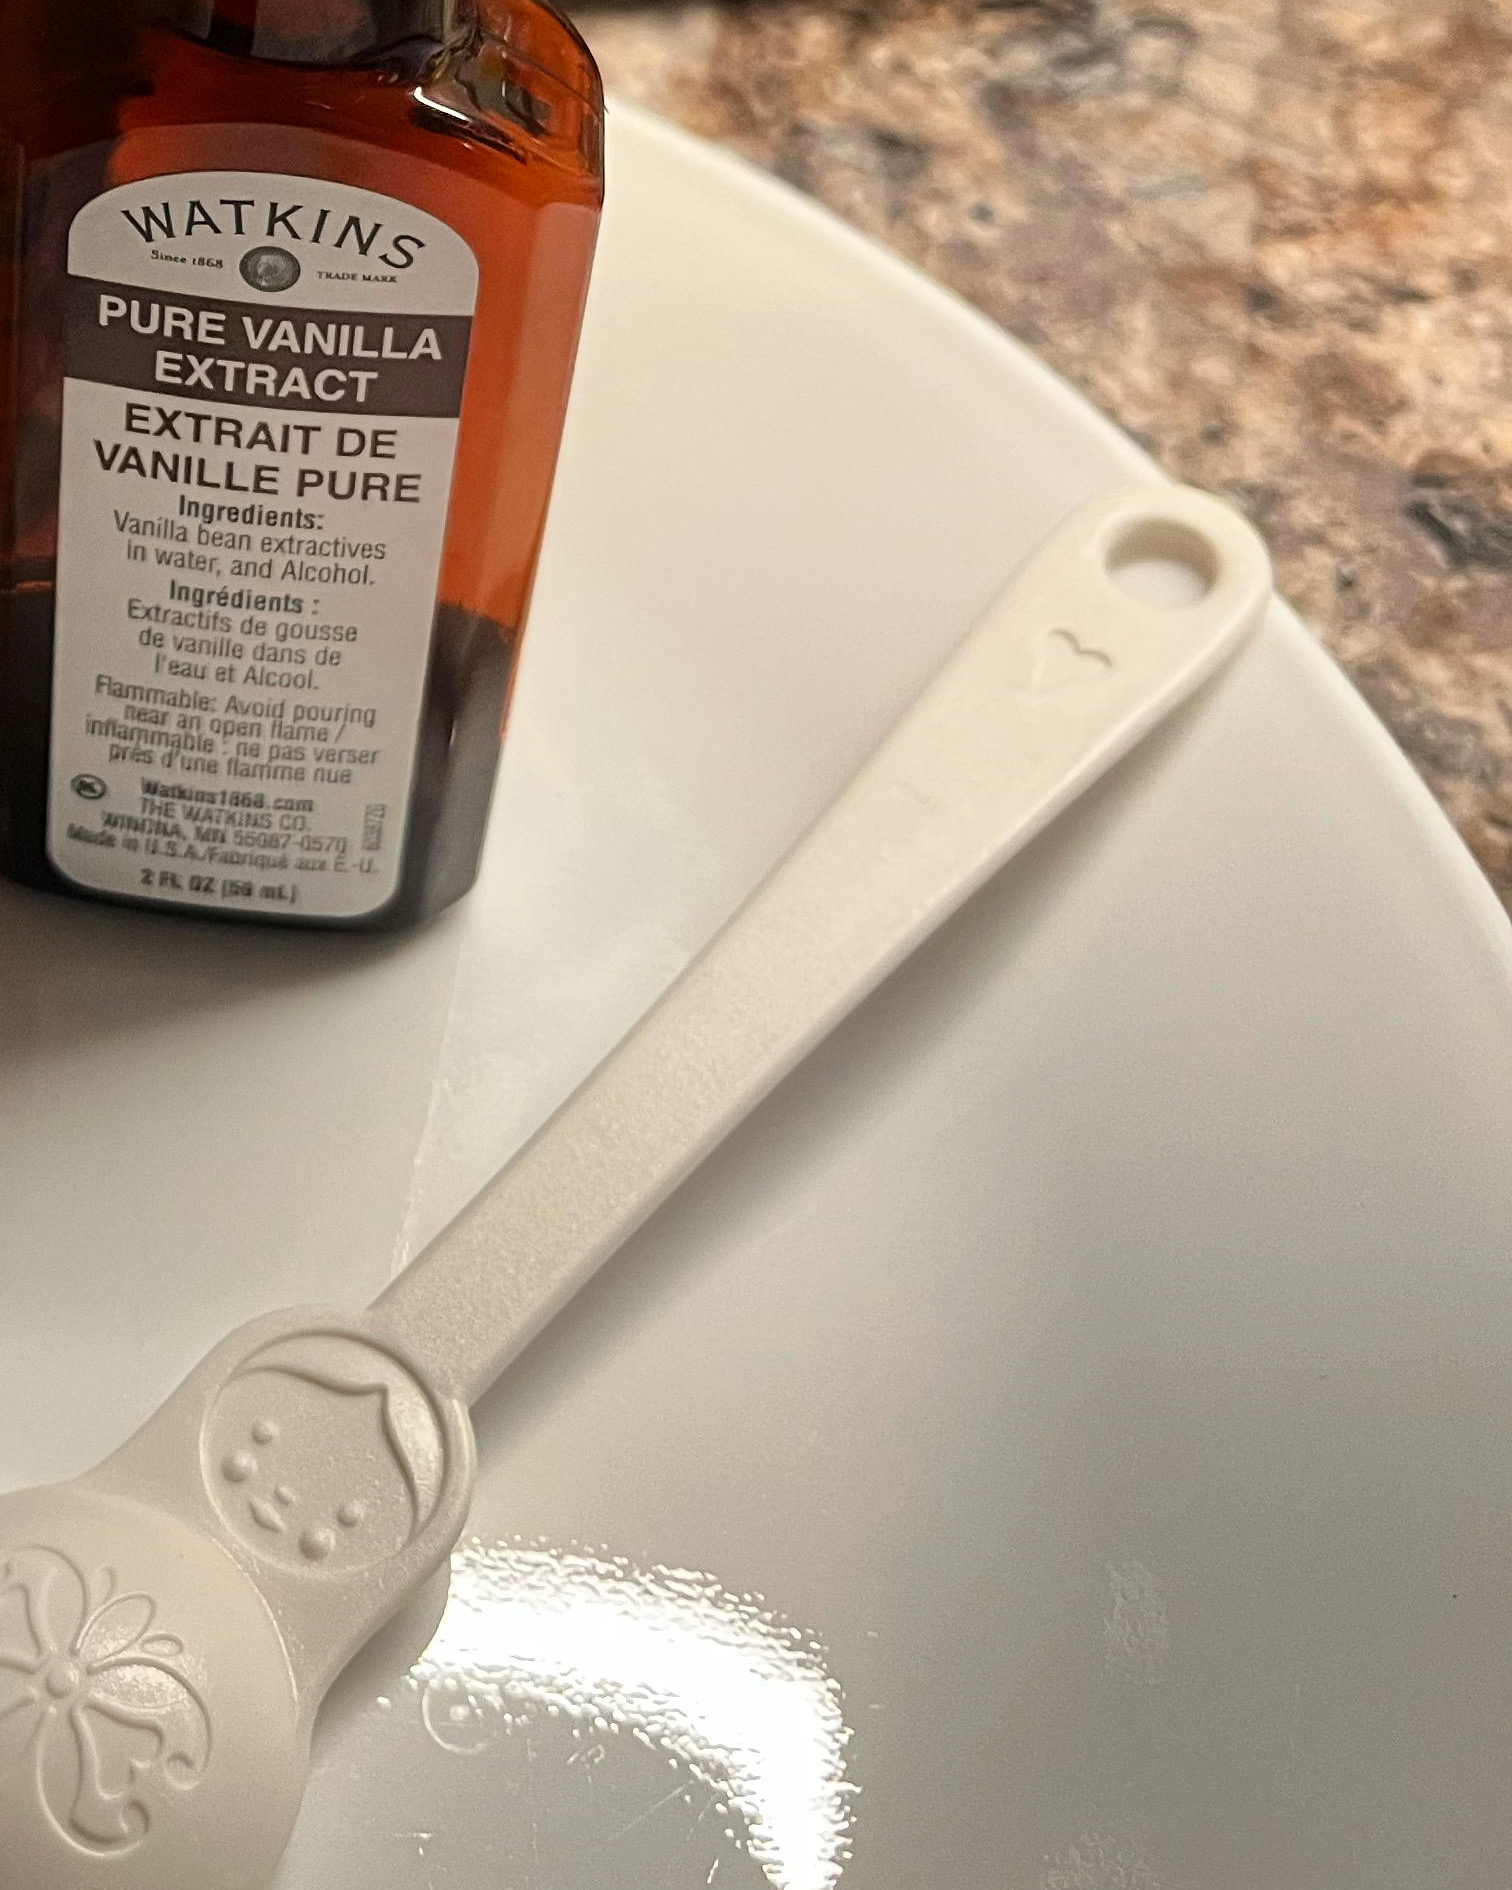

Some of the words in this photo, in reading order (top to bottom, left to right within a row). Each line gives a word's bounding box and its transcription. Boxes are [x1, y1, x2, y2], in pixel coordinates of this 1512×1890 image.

[121, 199, 425, 269] WATKINS
[151, 249, 187, 265] Since
[316, 271, 358, 283] TRADE
[362, 273, 398, 284] MARK
[98, 294, 226, 345] PURE
[242, 316, 442, 360] VANILLA
[155, 350, 378, 402] EXTRACT
[124, 402, 321, 455] EXTRAIT
[336, 428, 398, 459] DE
[94, 439, 280, 495] VANILLE
[297, 468, 422, 503] PURE
[179, 495, 325, 531] Ingredients:
[113, 510, 188, 542] Vanilla
[197, 524, 252, 551] bean
[261, 533, 386, 560] extractives
[126, 539, 147, 561] in
[155, 549, 221, 576] water,
[230, 557, 272, 579] and
[281, 560, 376, 586] Alcohol.
[169, 579, 303, 614] Ingrédients
[127, 598, 232, 633] Extractifs
[240, 614, 267, 637] de
[275, 621, 358, 643] gousse
[138, 626, 164, 648] de
[172, 634, 243, 660] vanille
[253, 642, 306, 666] dans
[315, 645, 342, 667] de
[215, 662, 236, 683] et
[243, 664, 320, 690] Alcool.
[176, 714, 201, 731] an
[224, 694, 285, 719] Avoid
[292, 703, 376, 728] pouring
